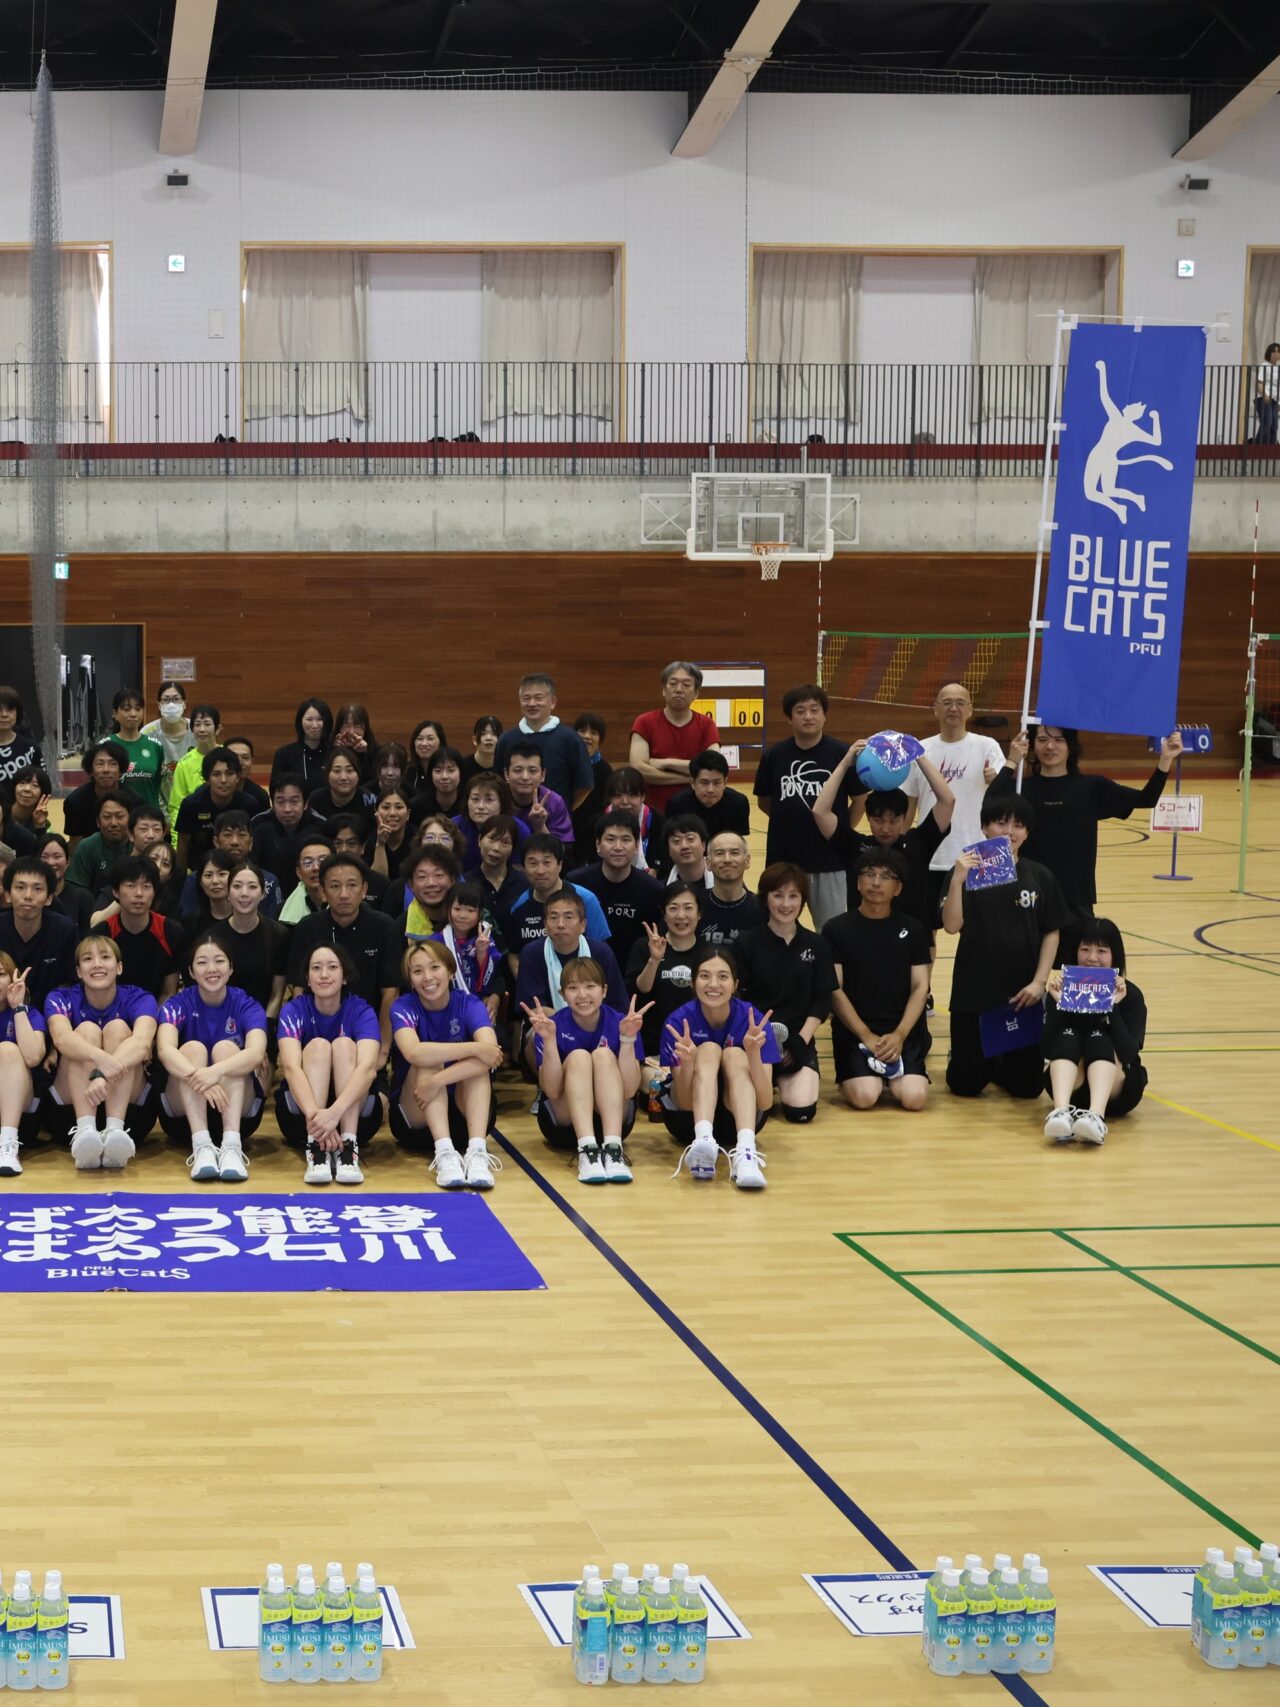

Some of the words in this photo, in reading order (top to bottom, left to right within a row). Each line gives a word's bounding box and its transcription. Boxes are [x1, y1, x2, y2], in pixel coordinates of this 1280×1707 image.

[1069, 534, 1170, 589] BLUE
[1064, 585, 1167, 640] CATS
[1130, 641, 1162, 656] PFU
[607, 906, 637, 919] PORT
